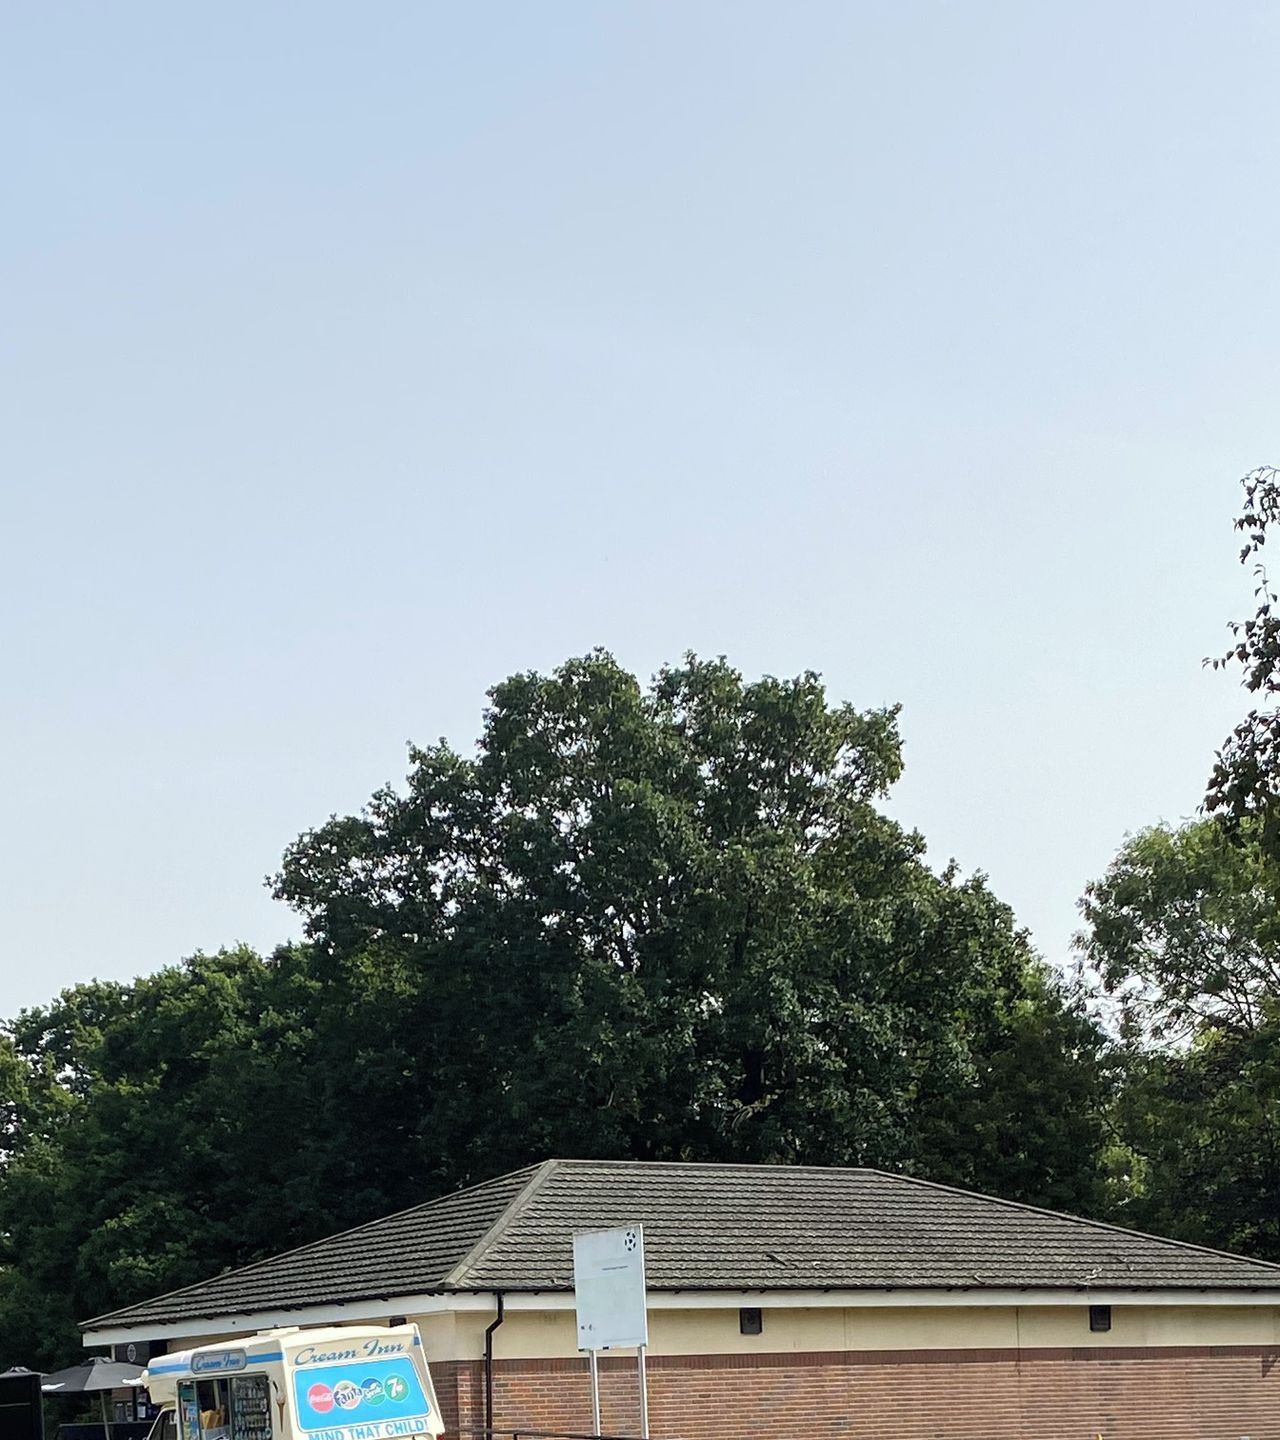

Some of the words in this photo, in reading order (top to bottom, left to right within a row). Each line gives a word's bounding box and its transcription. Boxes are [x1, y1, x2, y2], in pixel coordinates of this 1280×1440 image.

[294, 1347, 357, 1366] Cream
[363, 1338, 404, 1356] Inn
[333, 1386, 364, 1405] Fanta
[348, 1423, 381, 1440] THAT
[385, 1418, 428, 1436] CHILD!
